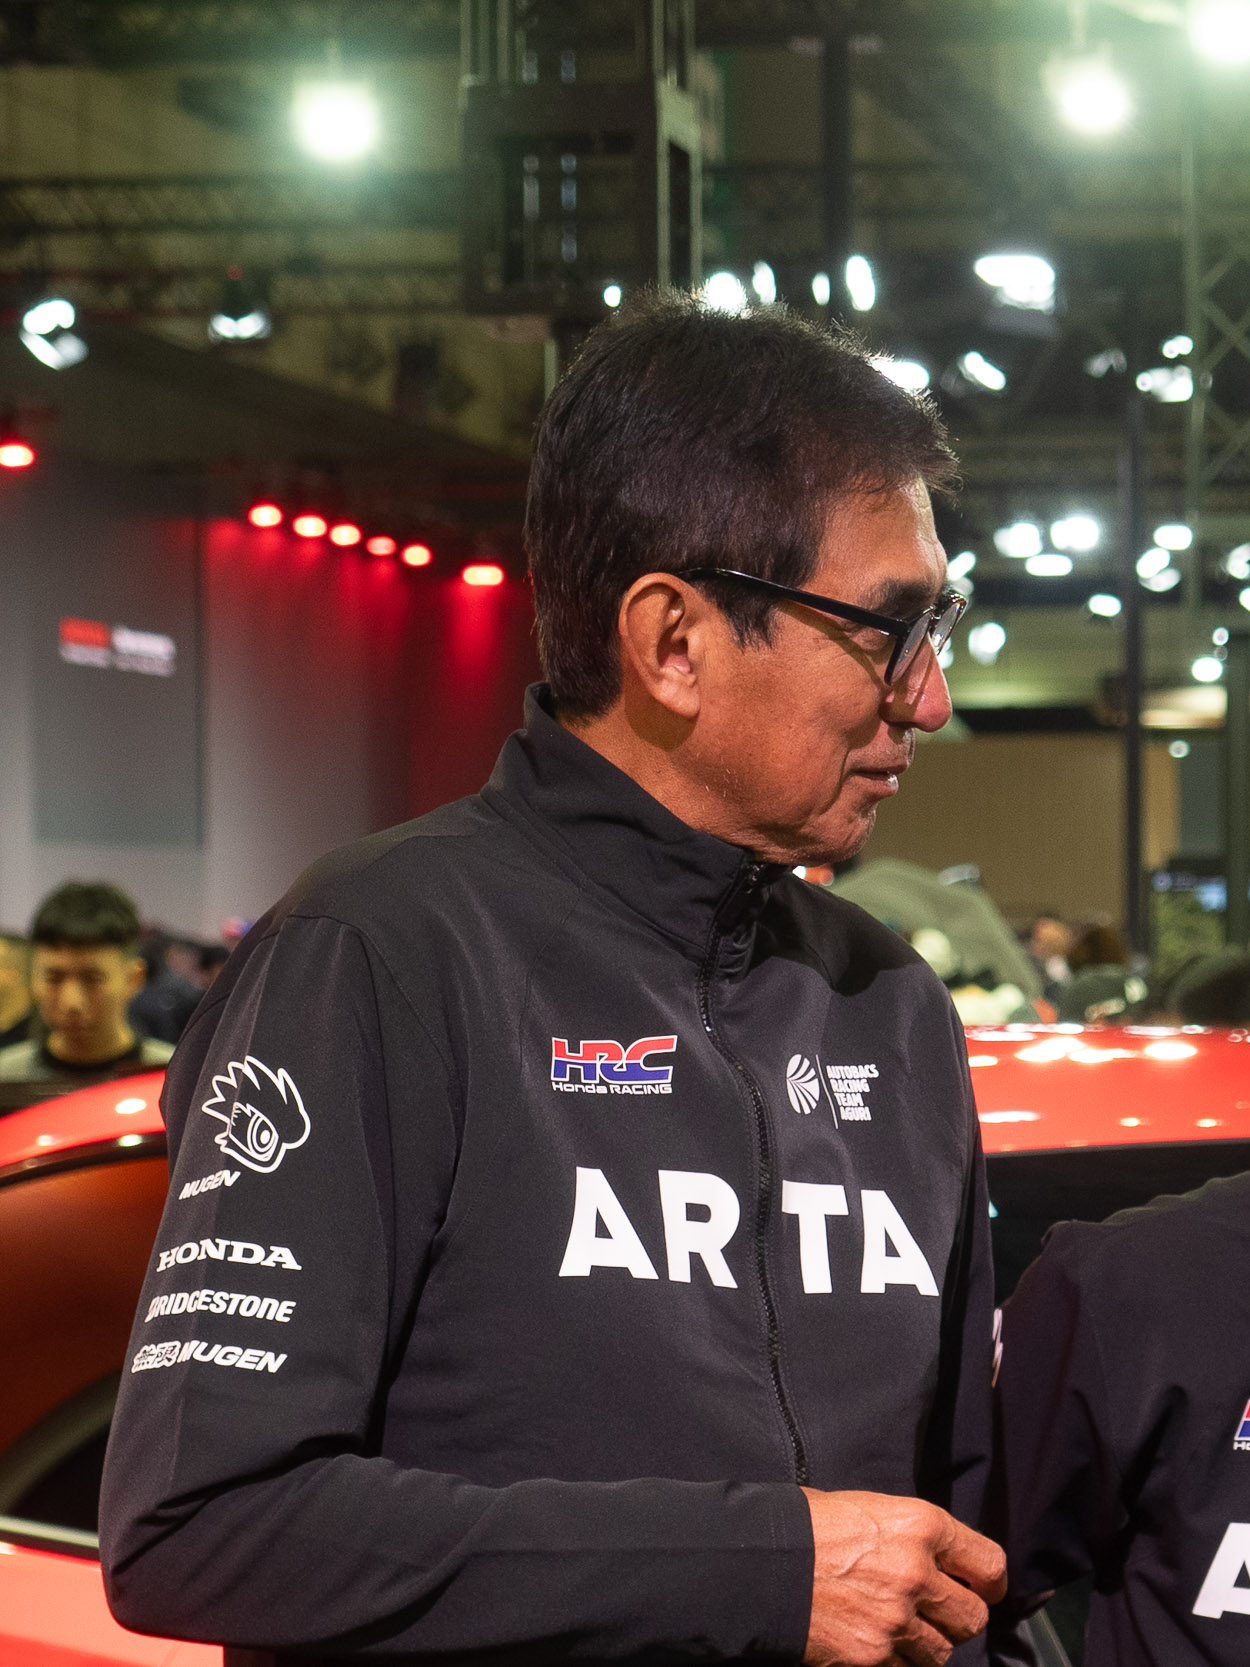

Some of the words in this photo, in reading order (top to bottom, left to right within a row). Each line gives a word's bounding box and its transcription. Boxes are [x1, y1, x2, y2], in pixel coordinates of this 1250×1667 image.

[551, 1035, 678, 1084] HRC
[826, 1064, 879, 1079] AUTOBACS
[551, 1082, 608, 1094] Honda
[609, 1083, 673, 1095] RACING
[830, 1079, 870, 1093] RACING
[834, 1092, 864, 1107] TEAM
[840, 1106, 872, 1121] AGURI
[179, 1170, 241, 1200] MUGEN
[156, 1238, 302, 1272] HONDA
[145, 1288, 296, 1323] BRIDGESTONE
